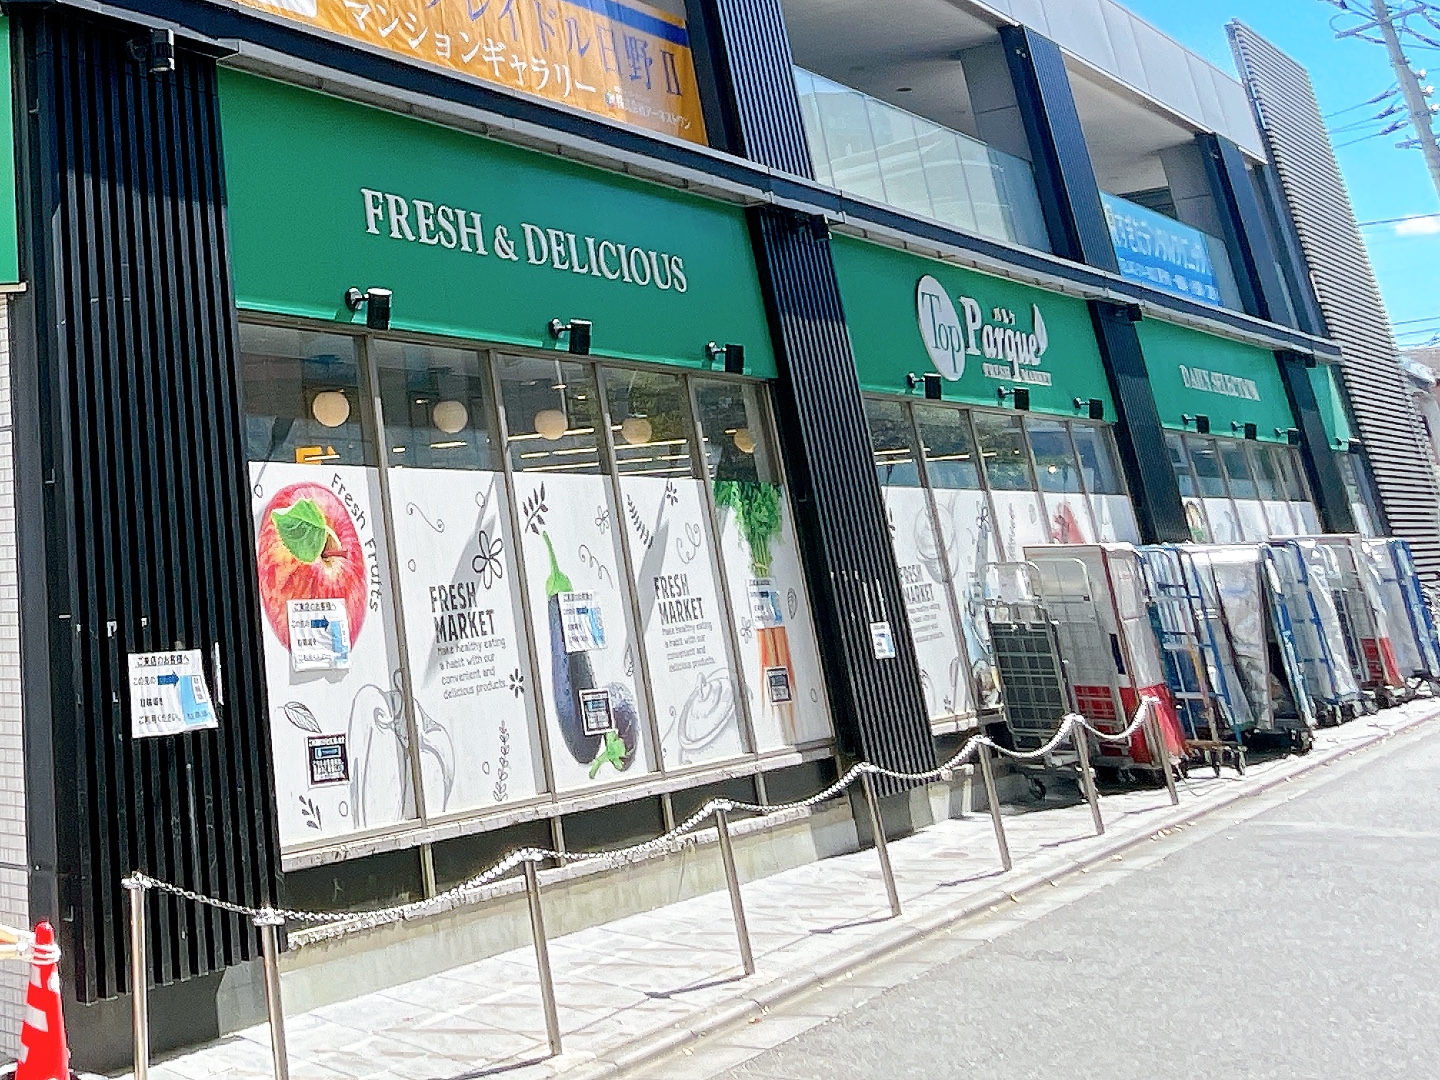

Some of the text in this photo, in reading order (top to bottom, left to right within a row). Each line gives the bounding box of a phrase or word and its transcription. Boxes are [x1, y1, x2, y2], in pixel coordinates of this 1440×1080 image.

[343, 0, 596, 98] マンションギャラリー
[360, 188, 688, 293] FRESH & DELICIOUS
[921, 291, 960, 374] Top
[959, 295, 1042, 382] Parque
[330, 472, 383, 612] Fresh Fruits
[429, 582, 478, 613] FRESH
[434, 609, 495, 643] MARKET
[653, 574, 690, 600] FRESH
[658, 597, 704, 626] MARKET
